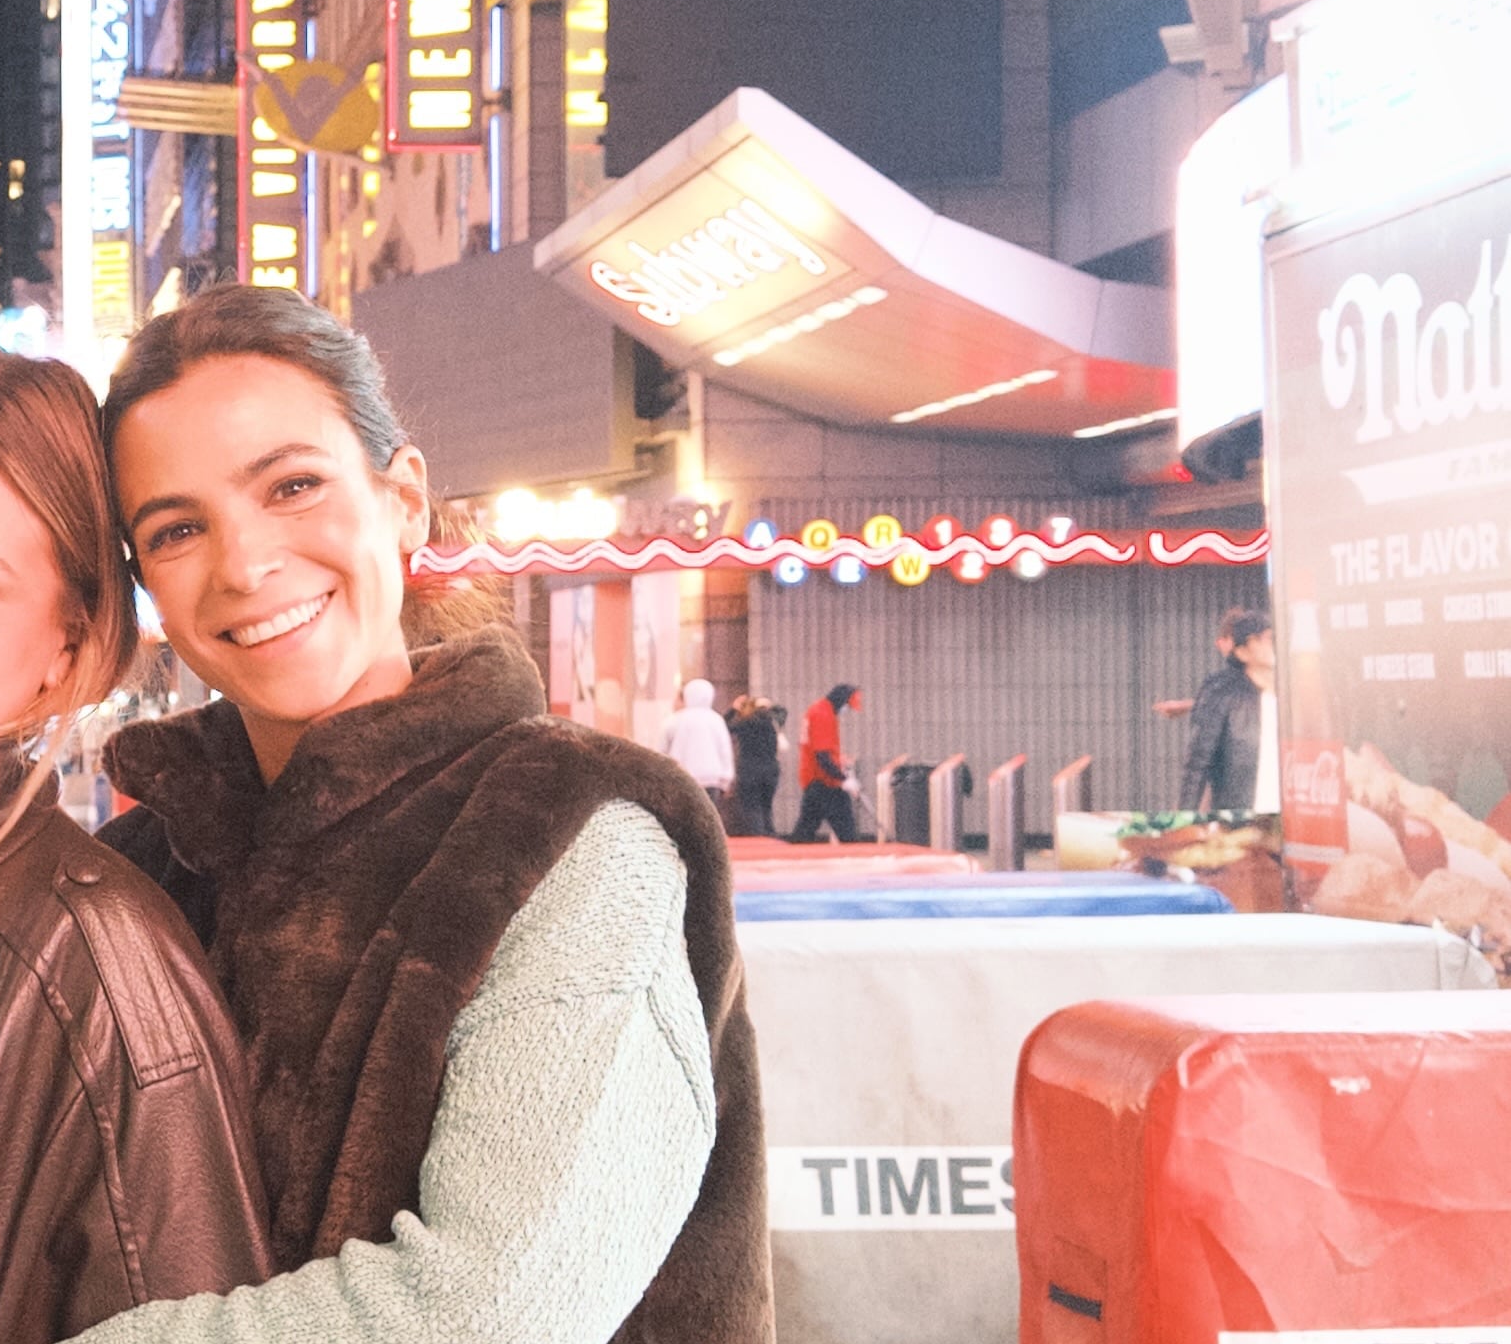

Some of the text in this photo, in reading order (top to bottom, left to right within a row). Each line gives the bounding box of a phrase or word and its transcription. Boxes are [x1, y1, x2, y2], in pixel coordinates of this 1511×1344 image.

[251, 223, 297, 290] EW
[590, 197, 826, 326] Subway
[750, 522, 775, 548] A
[934, 519, 952, 546] 1
[1049, 516, 1073, 545] 7
[1329, 521, 1501, 586] THE FLAVOR
